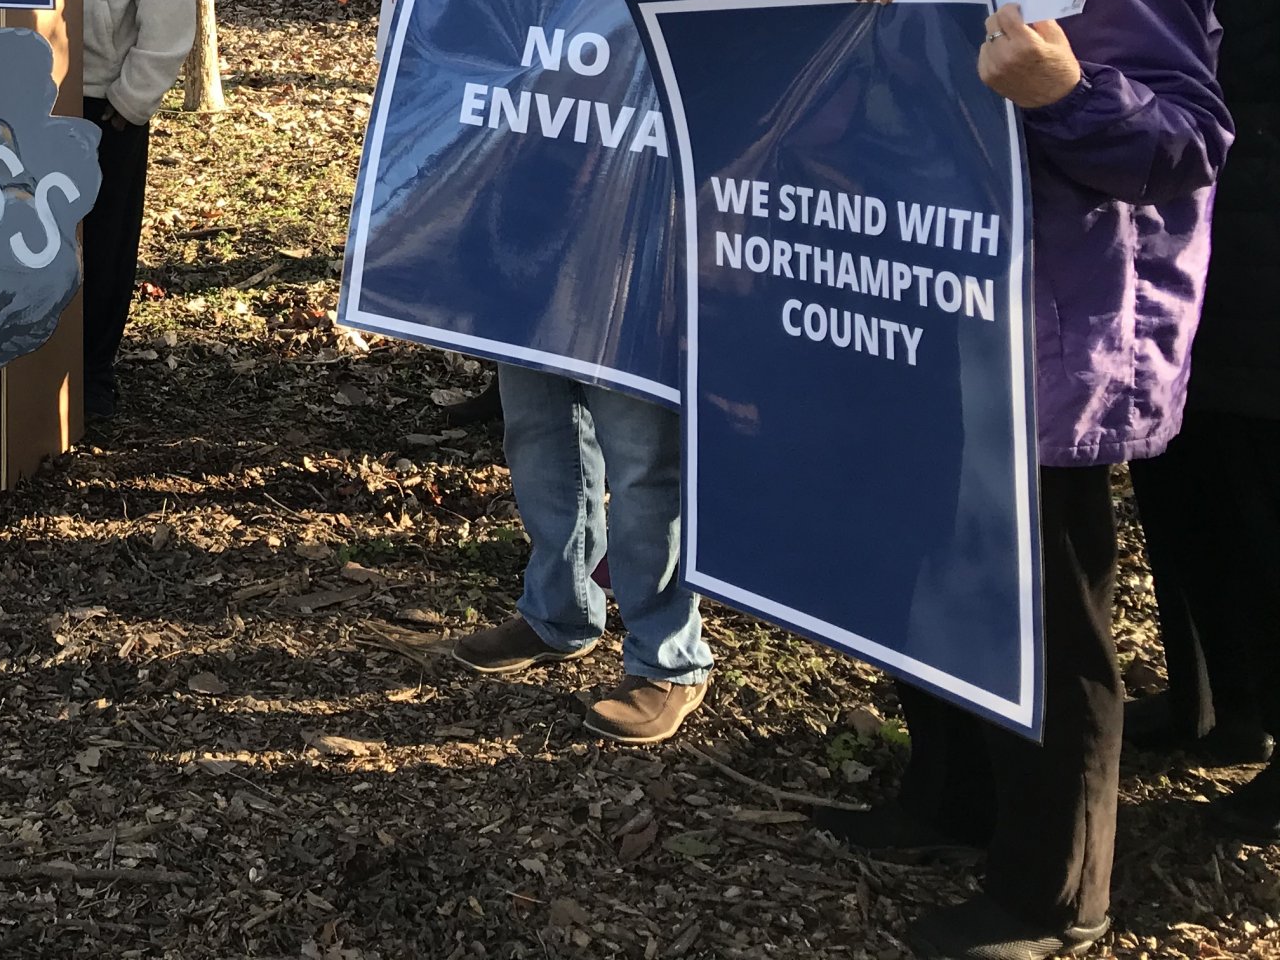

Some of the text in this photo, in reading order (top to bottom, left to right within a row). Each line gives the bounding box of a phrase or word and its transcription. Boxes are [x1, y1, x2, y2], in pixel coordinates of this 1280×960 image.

[520, 25, 610, 77] NO
[459, 82, 669, 158] ENVIVA
[710, 176, 1000, 257] WE STAND WITH
[715, 231, 995, 322] NORTHAMPTON
[781, 298, 924, 367] COUNTY
